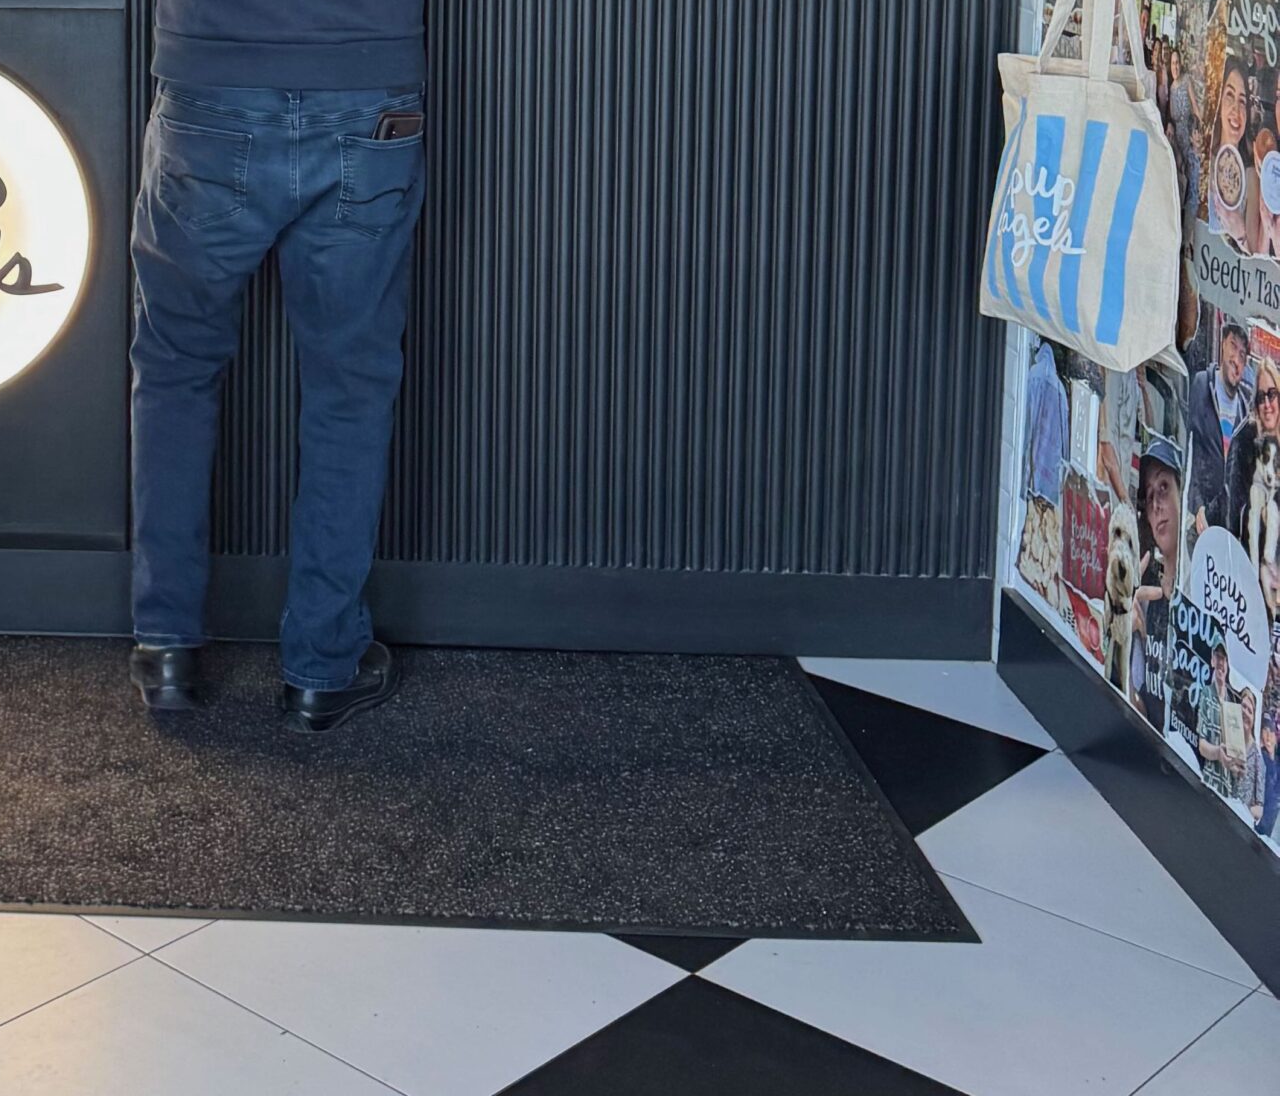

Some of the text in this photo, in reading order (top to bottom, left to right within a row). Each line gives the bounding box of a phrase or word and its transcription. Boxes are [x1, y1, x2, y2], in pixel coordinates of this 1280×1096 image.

[1200, 244, 1251, 305] Seedy.
[1204, 580, 1256, 654] Bagels
[1145, 634, 1163, 661] Not
[1169, 710, 1199, 748] famous
